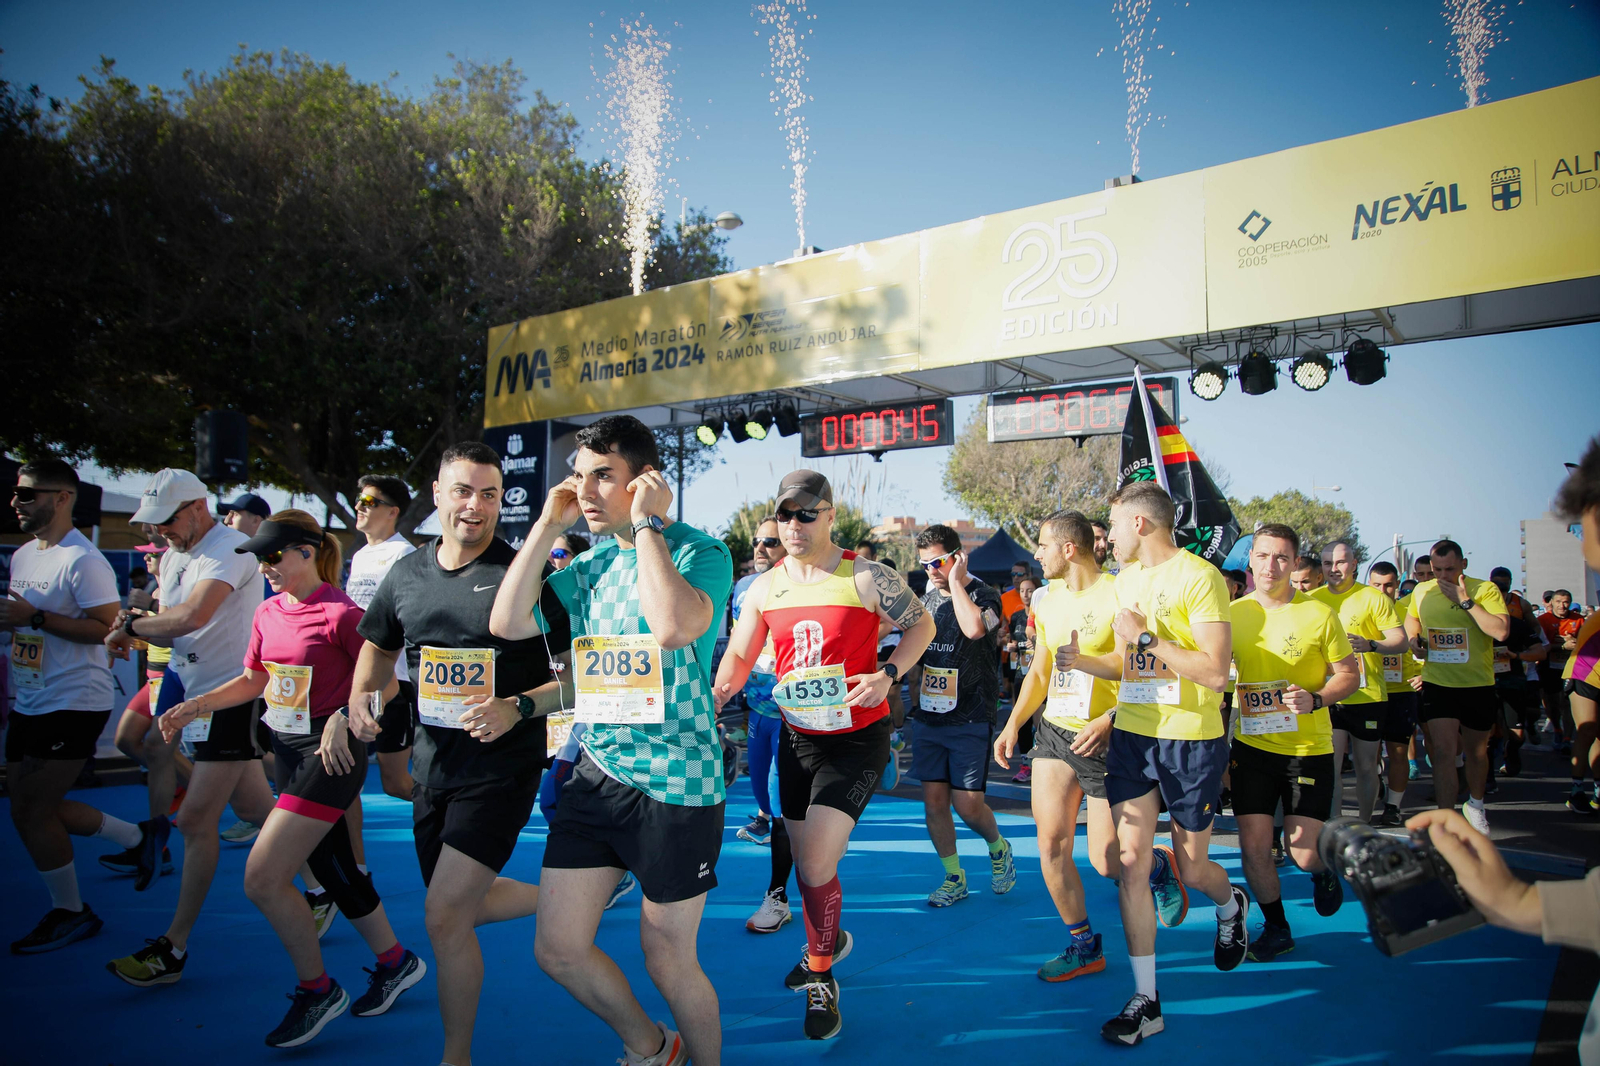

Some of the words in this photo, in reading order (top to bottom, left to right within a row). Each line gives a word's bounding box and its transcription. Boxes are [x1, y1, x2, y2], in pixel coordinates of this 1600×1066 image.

[1551, 176, 1600, 197] CIUD
[1237, 233, 1329, 258] COOPERACIÓN
[1360, 228, 1382, 240] 2020
[1002, 206, 1119, 311] 25
[1238, 255, 1268, 269] 2005
[1001, 301, 1119, 341] EDICIÓN
[581, 336, 628, 358] Medio
[634, 321, 706, 348] Maratón
[717, 342, 764, 362] RAMÓN
[769, 337, 802, 354] RUIZ
[807, 324, 877, 348] ANDÚJAR
[579, 353, 647, 383] Almería
[651, 343, 706, 372] 2024
[14, 642, 38, 660] 70
[1432, 634, 1464, 645] 1988
[424, 661, 485, 686] 2082
[585, 650, 652, 676] 2083
[437, 686, 462, 694] DANIEL
[603, 677, 628, 685] DANIEL
[783, 677, 840, 700] 1533
[925, 674, 948, 690] 528
[1243, 689, 1284, 708] 1981
[846, 769, 878, 808] FILA
